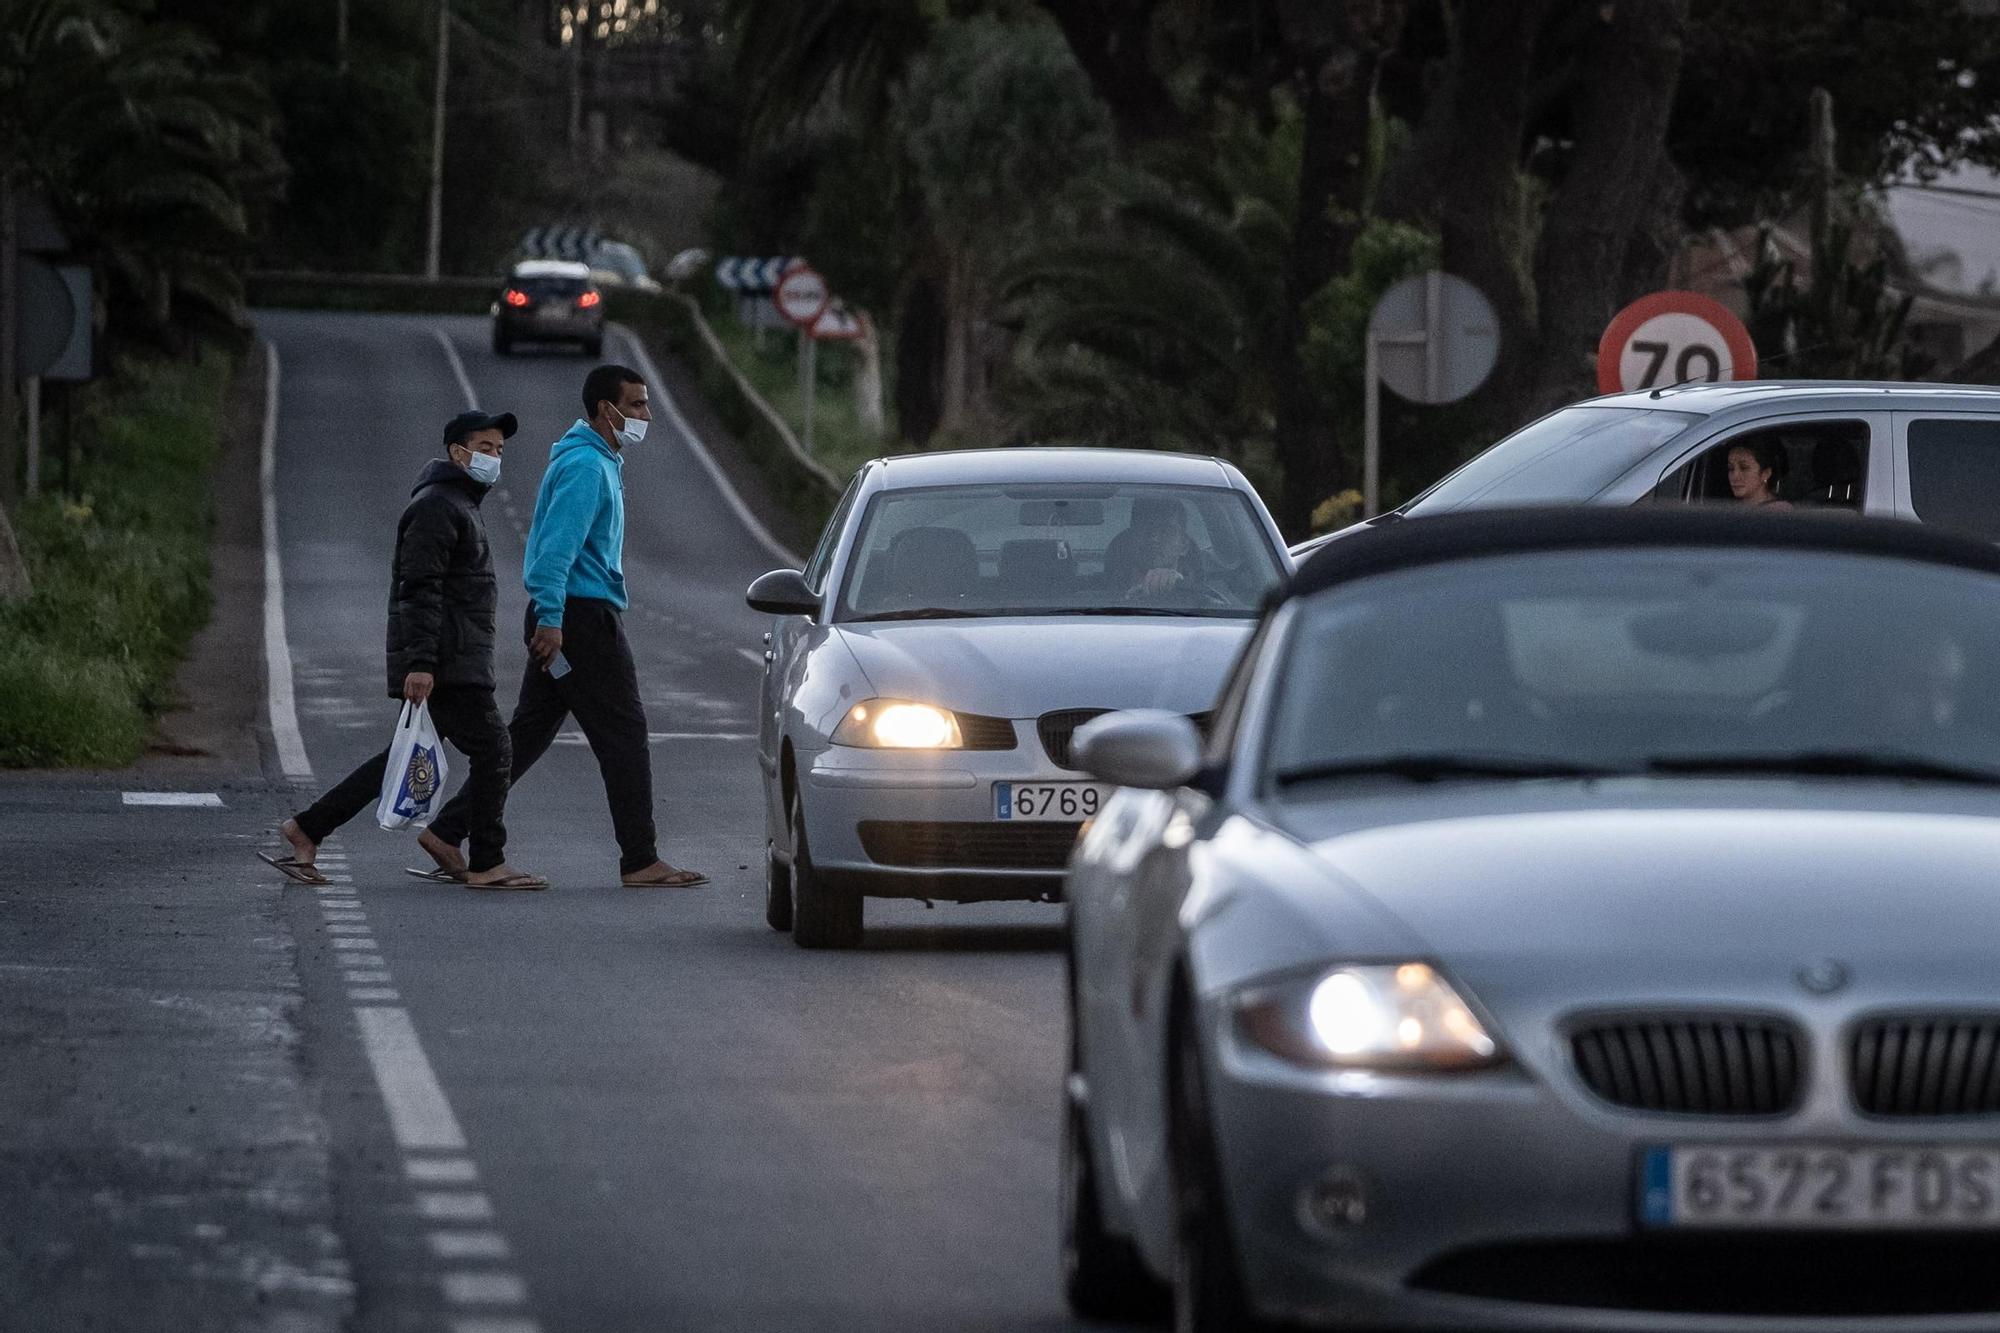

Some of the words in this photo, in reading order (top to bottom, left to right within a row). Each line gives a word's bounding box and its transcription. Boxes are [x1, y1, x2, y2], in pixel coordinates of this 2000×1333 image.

[1632, 340, 1720, 390] 70
[1018, 788, 1099, 815] 6769
[1685, 1152, 1849, 1214] 6572
